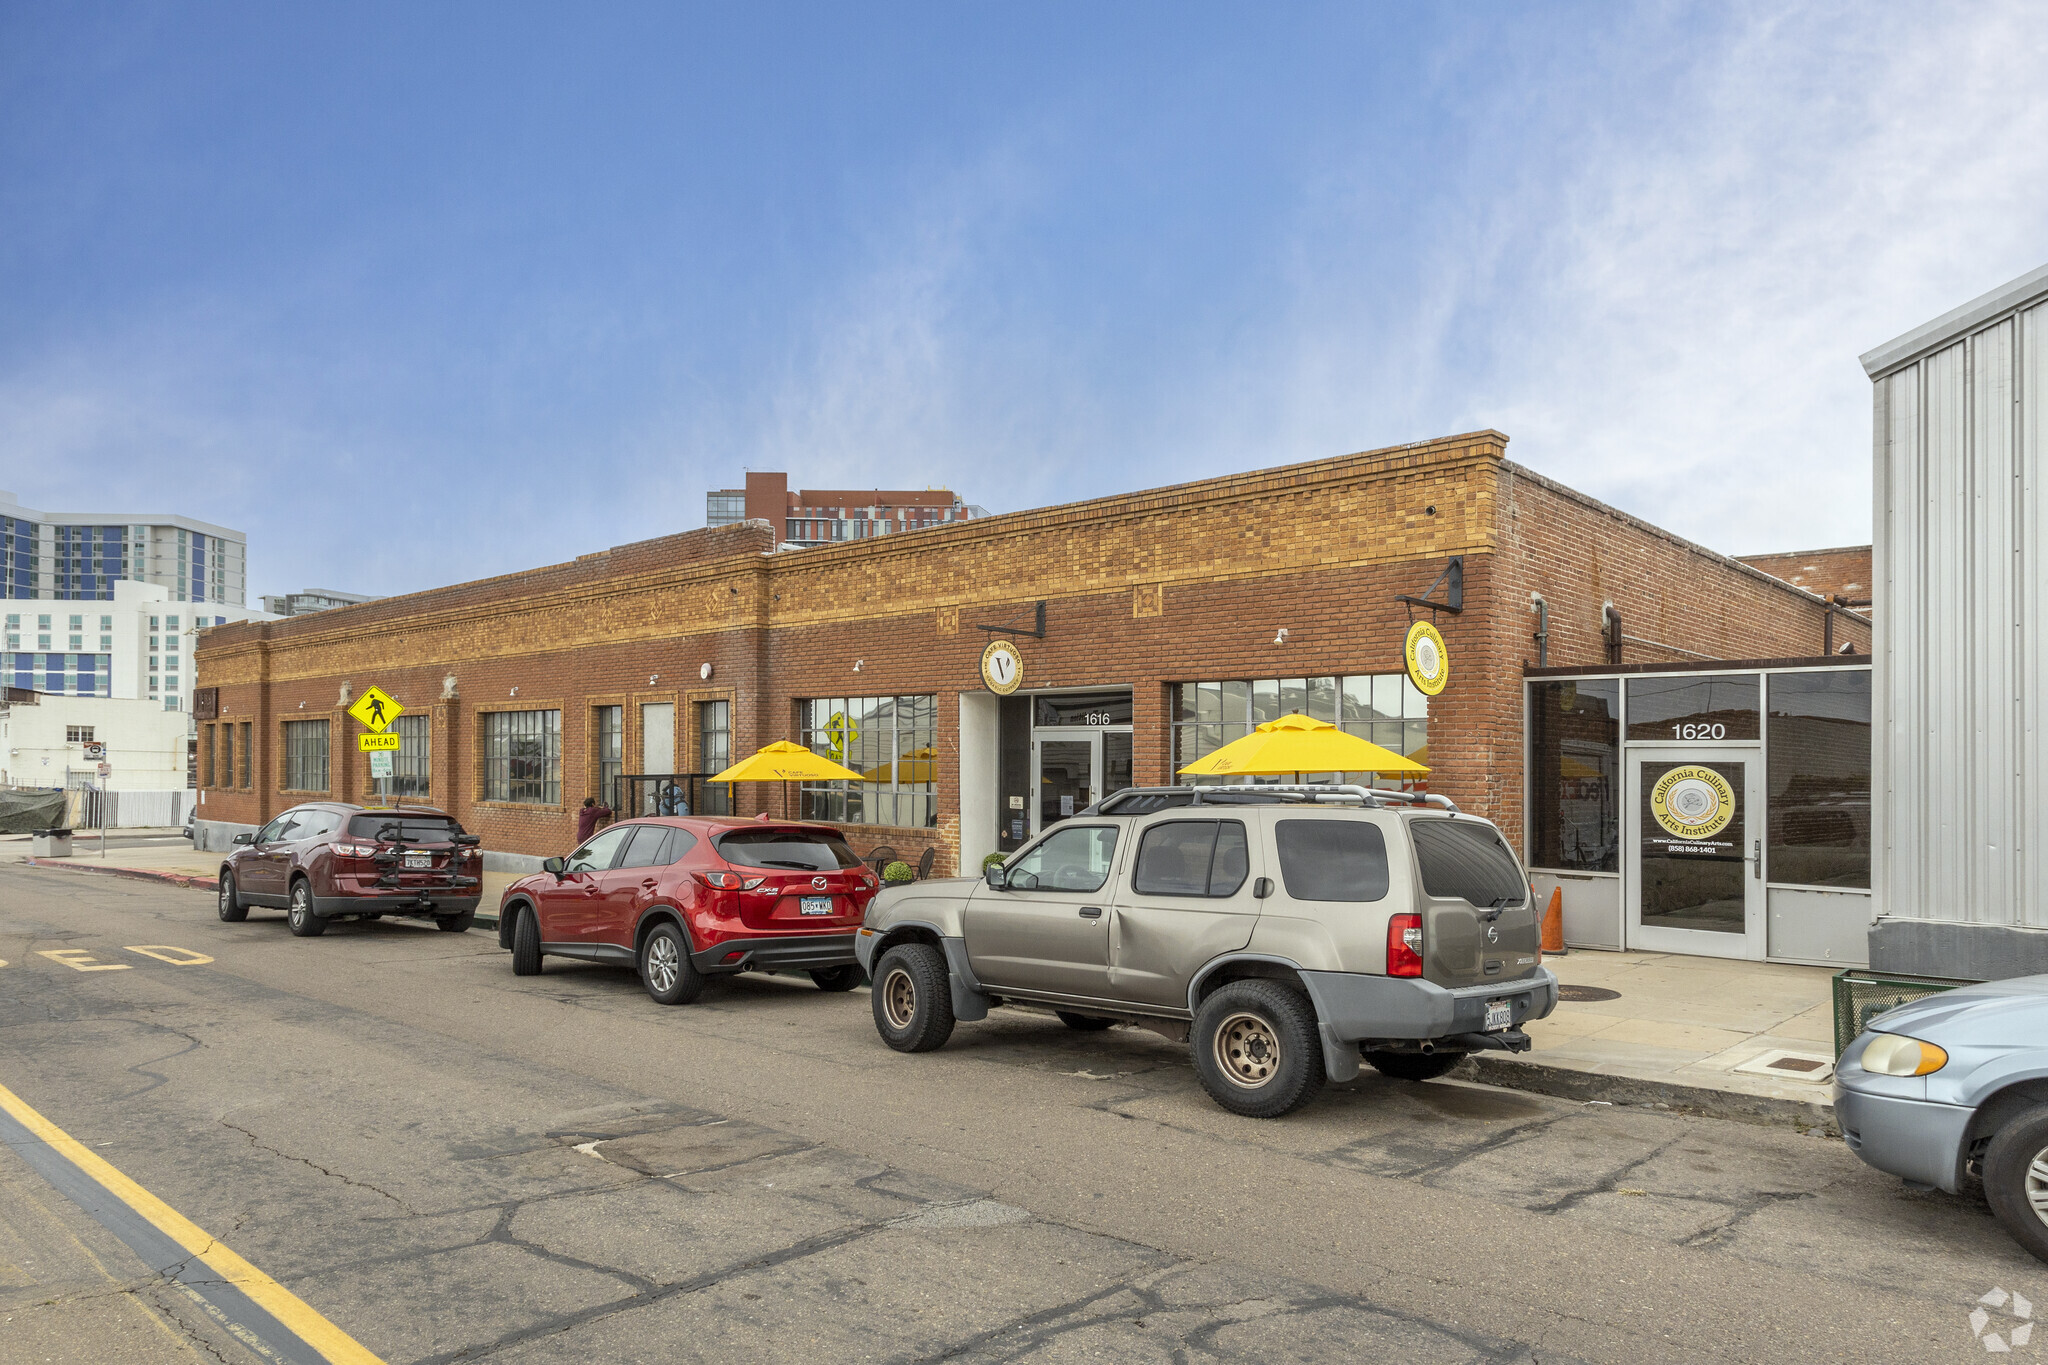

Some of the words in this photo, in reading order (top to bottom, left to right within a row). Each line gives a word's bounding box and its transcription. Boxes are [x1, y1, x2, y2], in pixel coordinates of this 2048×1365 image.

[985, 644, 997, 659] CAFE
[998, 642, 1021, 664] VIRTUOSO
[1410, 627, 1426, 661] California
[1425, 628, 1444, 660] Culinary
[1414, 669, 1426, 686] Arts
[1426, 668, 1445, 688] Institute
[1084, 713, 1110, 726] 1616
[1671, 723, 1726, 740] 1620
[364, 737, 396, 747] AHEAD
[1654, 769, 1694, 804] California
[1696, 769, 1729, 806] Culinary
[1659, 813, 1680, 834] Arts
[1680, 815, 1726, 835] Institute
[1668, 845, 1685, 853] (858)
[1685, 845, 1717, 854] 868-1401
[802, 901, 815, 911] 085
